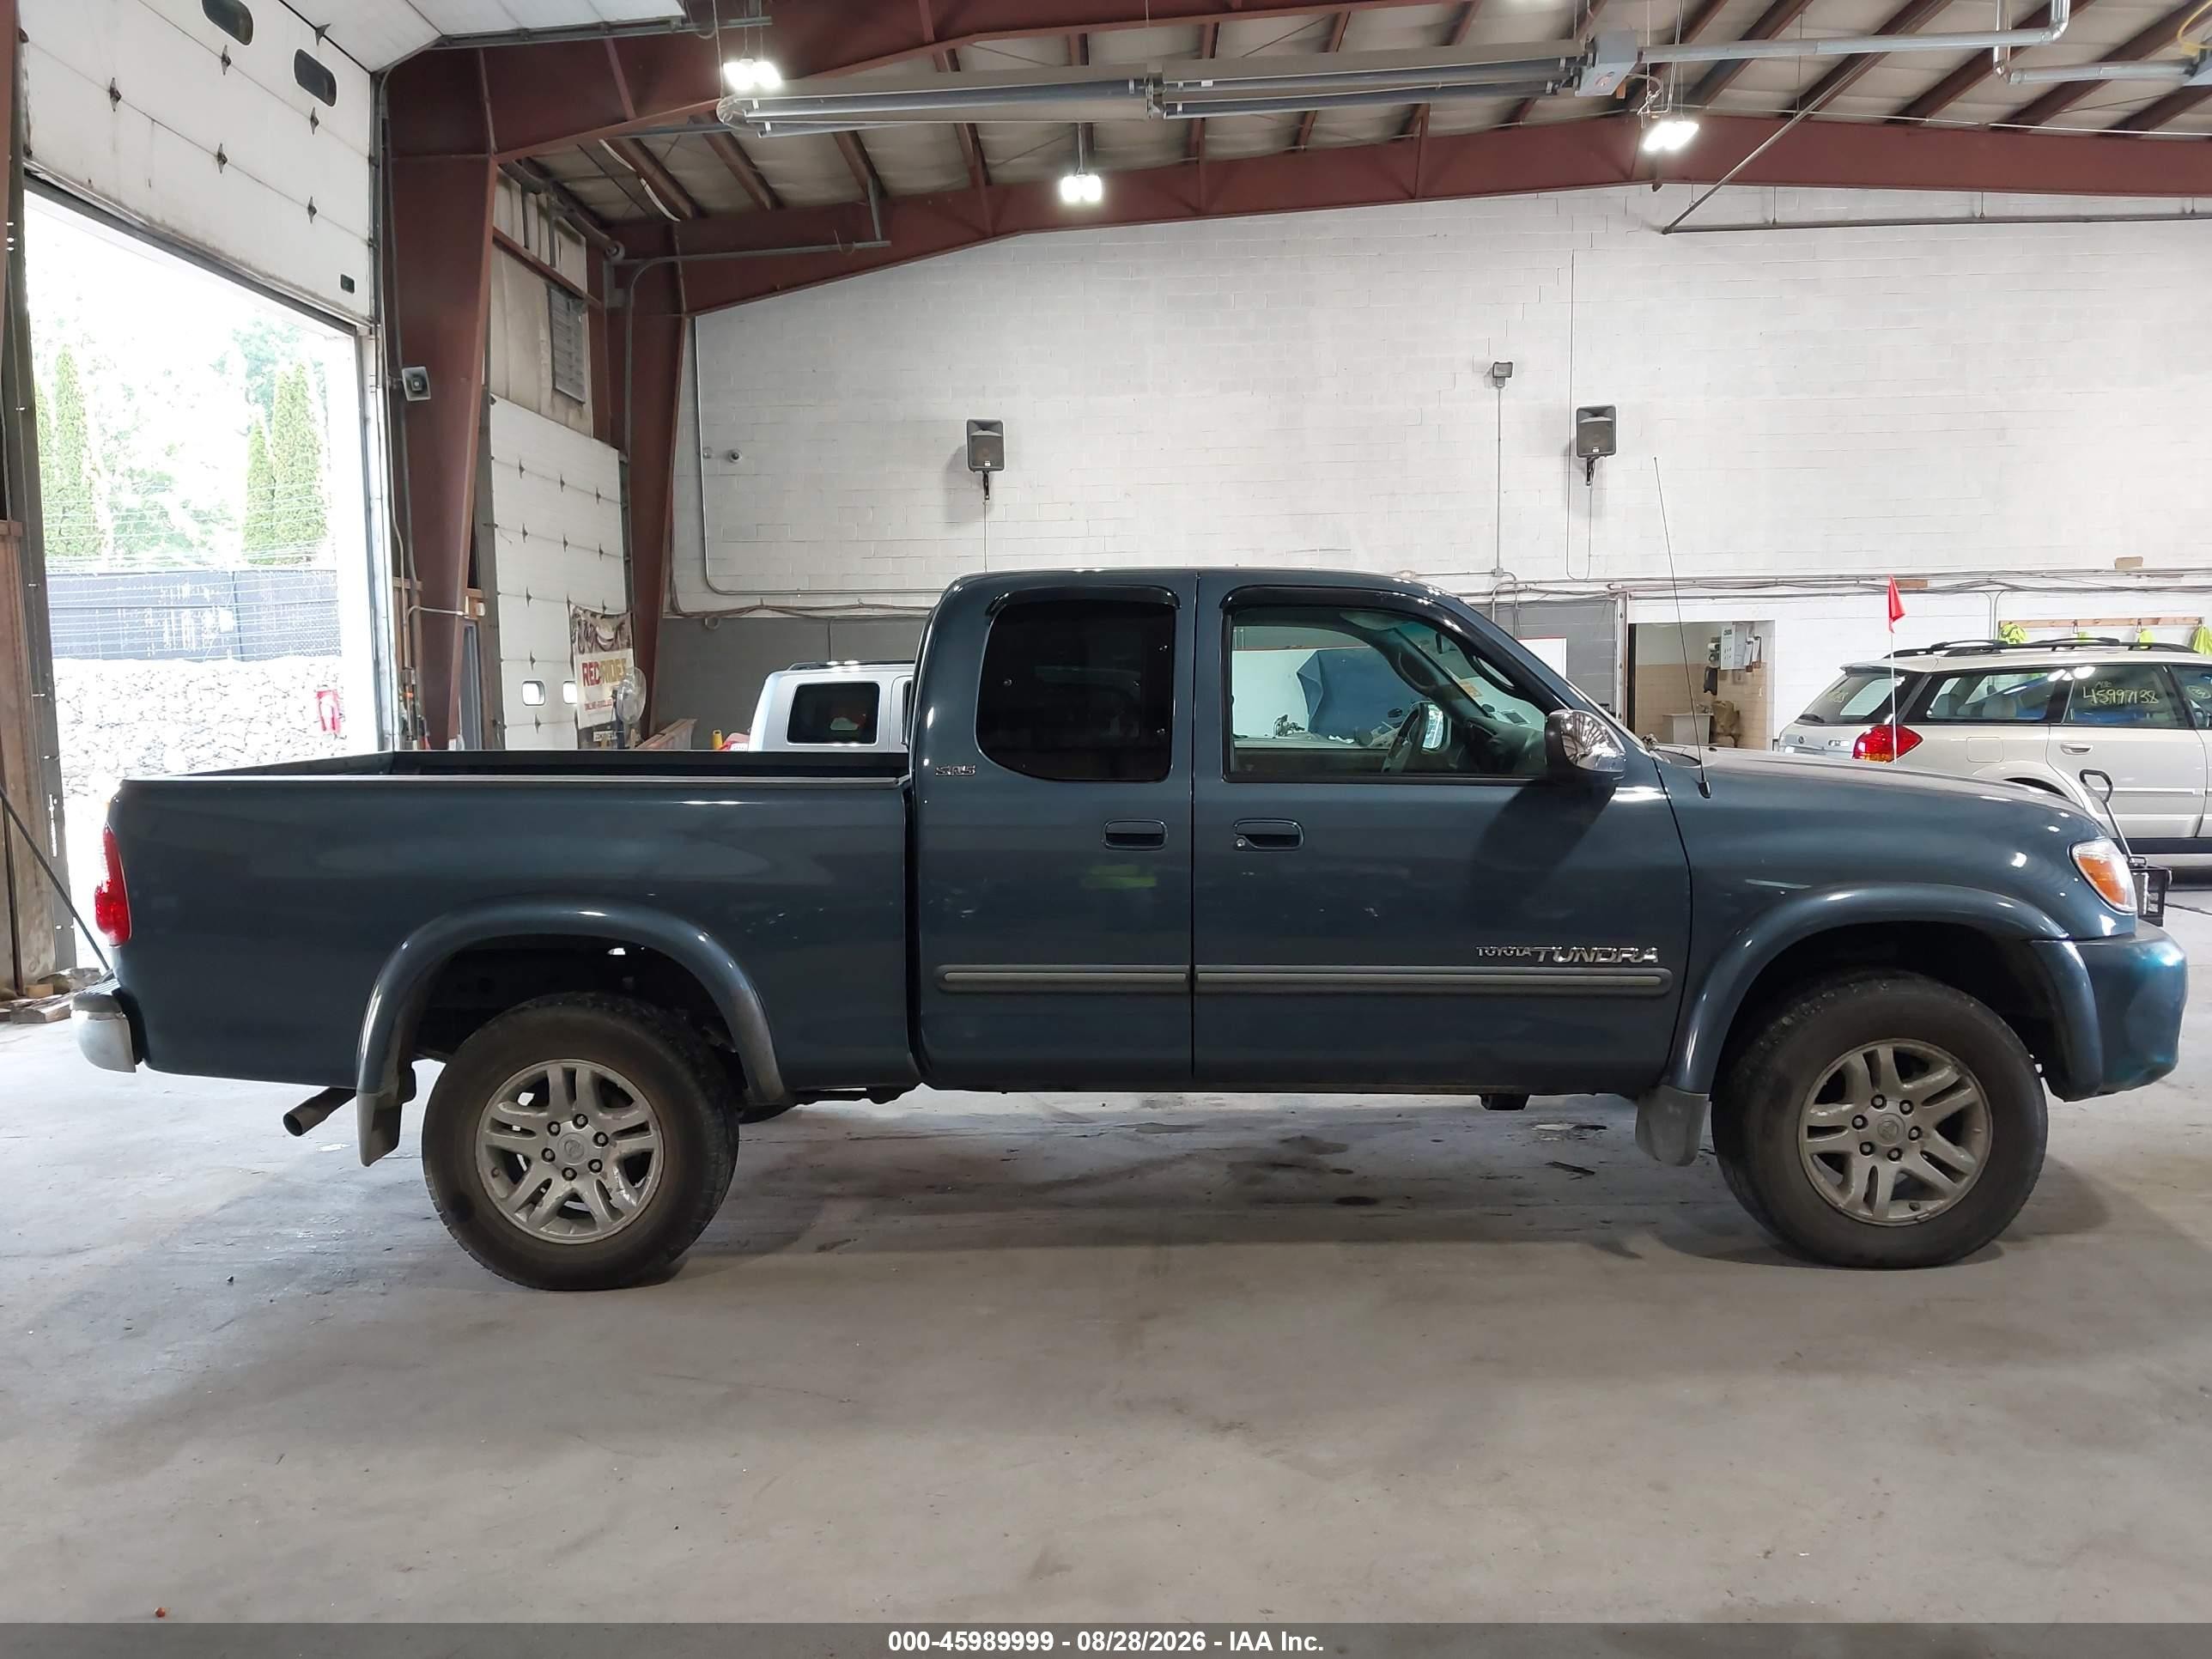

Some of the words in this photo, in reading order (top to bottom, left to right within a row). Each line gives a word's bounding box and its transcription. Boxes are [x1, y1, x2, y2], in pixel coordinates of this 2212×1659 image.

[2082, 686, 2160, 704] 45997138
[935, 764, 976, 777] SR5
[1476, 946, 1532, 957] TOYOTA
[1532, 946, 1658, 963] TUNDRA
